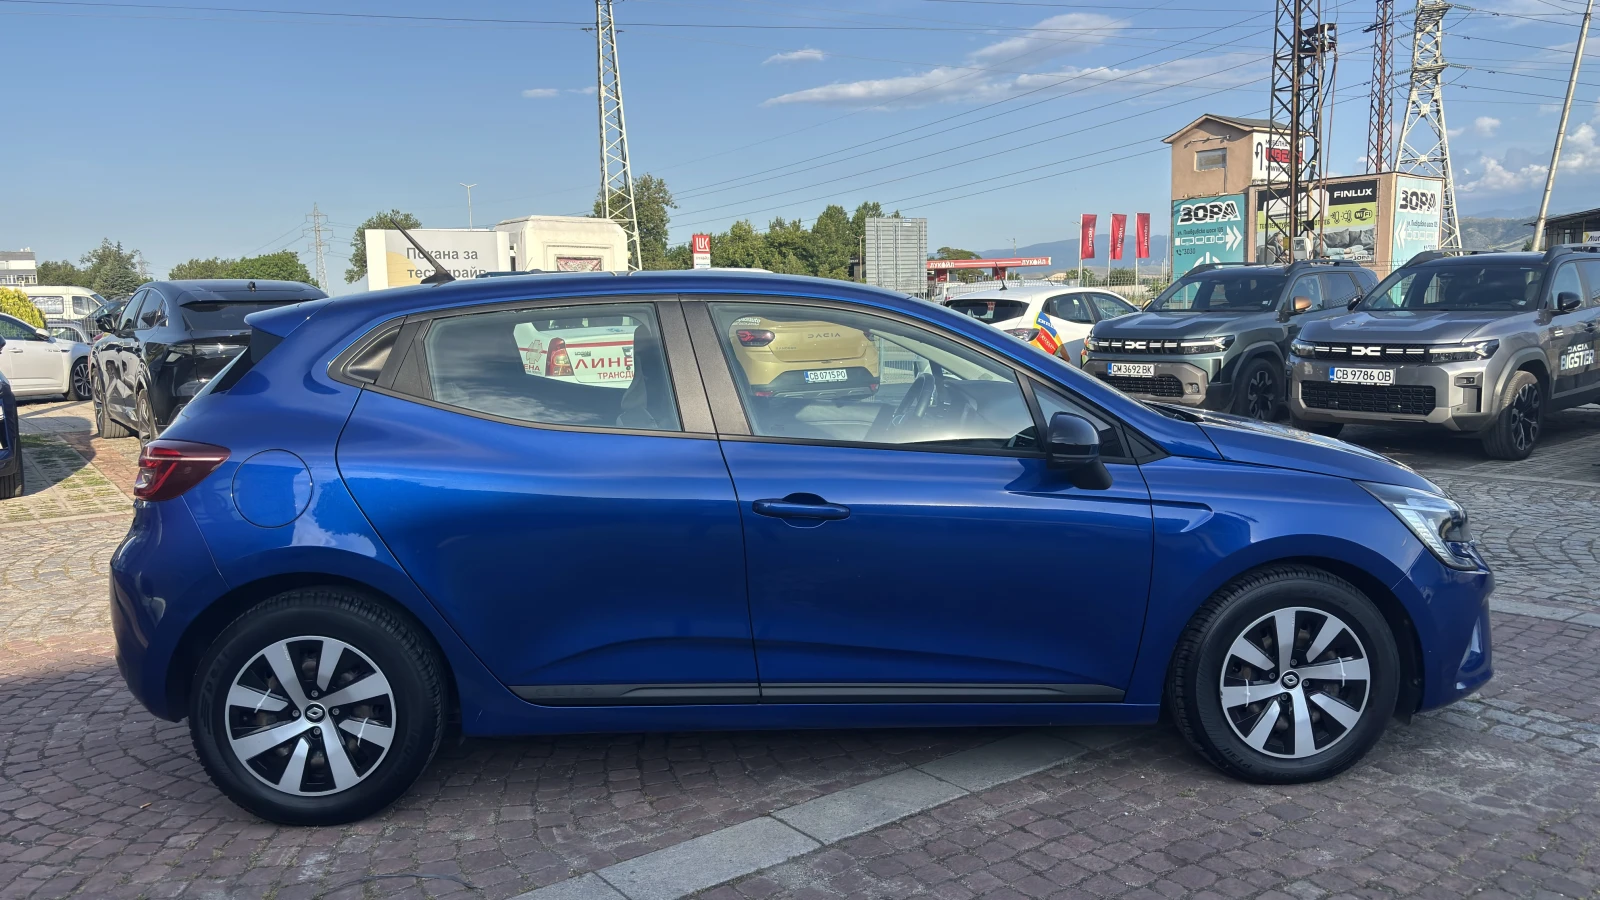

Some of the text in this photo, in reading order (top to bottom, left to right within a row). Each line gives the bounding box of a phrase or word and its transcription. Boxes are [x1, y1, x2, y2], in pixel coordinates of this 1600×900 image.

[1333, 188, 1373, 198] FINLUX
[1178, 202, 1240, 224] ЗОРА
[464, 251, 478, 259] за
[1567, 343, 1589, 353] DACIA
[575, 357, 633, 369] ЛИНЕ
[1560, 349, 1595, 370] BIGSTER
[1123, 365, 1141, 374] 3692
[1142, 365, 1153, 374] BK
[1335, 369, 1391, 382] CB 9786 OB
